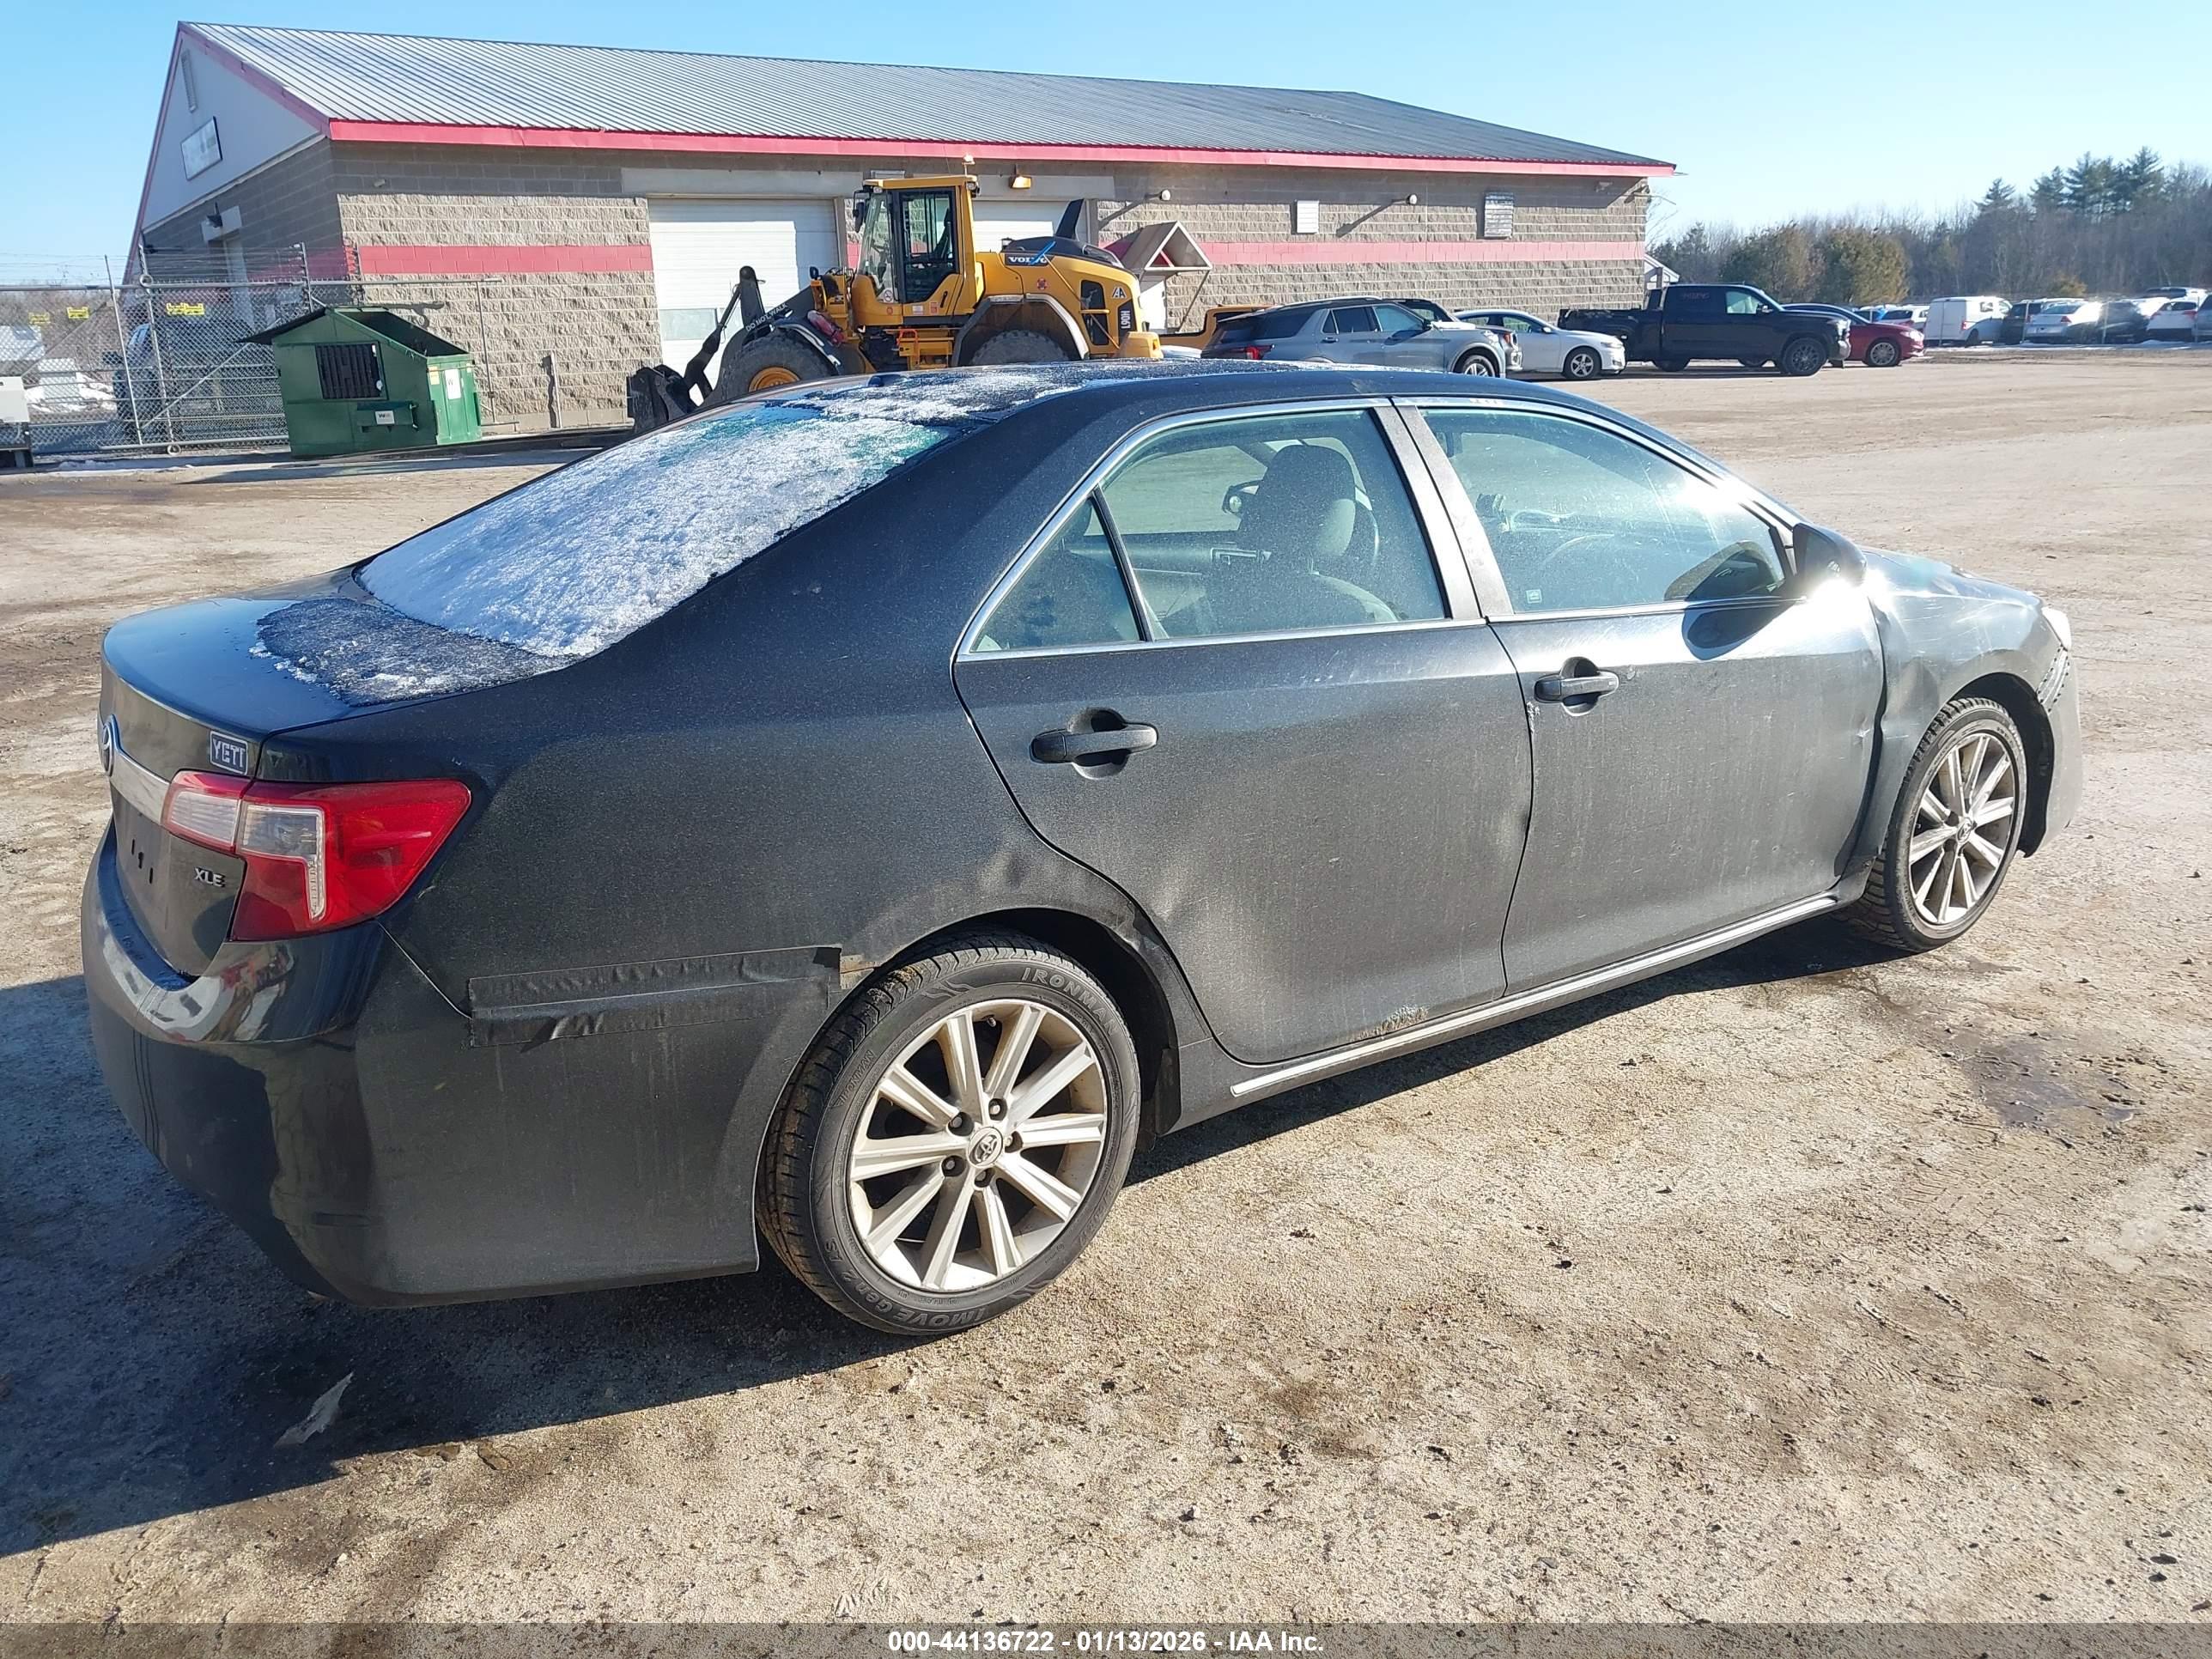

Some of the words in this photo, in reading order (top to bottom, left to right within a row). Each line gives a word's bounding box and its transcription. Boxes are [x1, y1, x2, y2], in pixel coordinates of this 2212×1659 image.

[745, 323, 756, 331] DO
[1120, 310, 1131, 329] L90H
[212, 738, 246, 768] YETI
[194, 866, 226, 887] XLE
[1021, 967, 1118, 1036] IRONMAN
